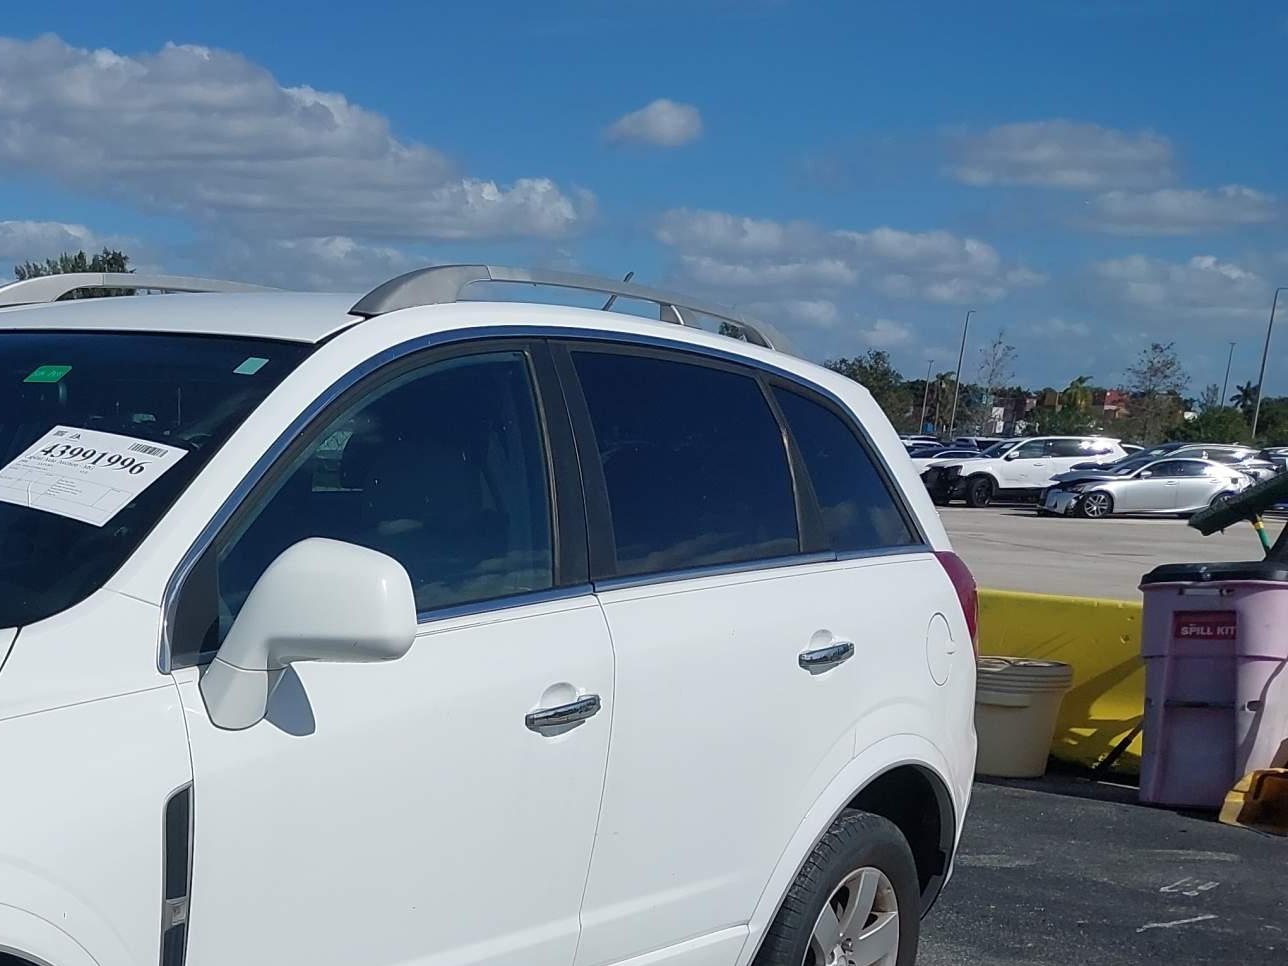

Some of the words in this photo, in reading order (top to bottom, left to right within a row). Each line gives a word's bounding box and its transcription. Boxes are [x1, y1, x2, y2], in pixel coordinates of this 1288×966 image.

[40, 443, 153, 475] 43991996
[1180, 625, 1214, 636] SPILL
[1216, 625, 1237, 636] KIT
